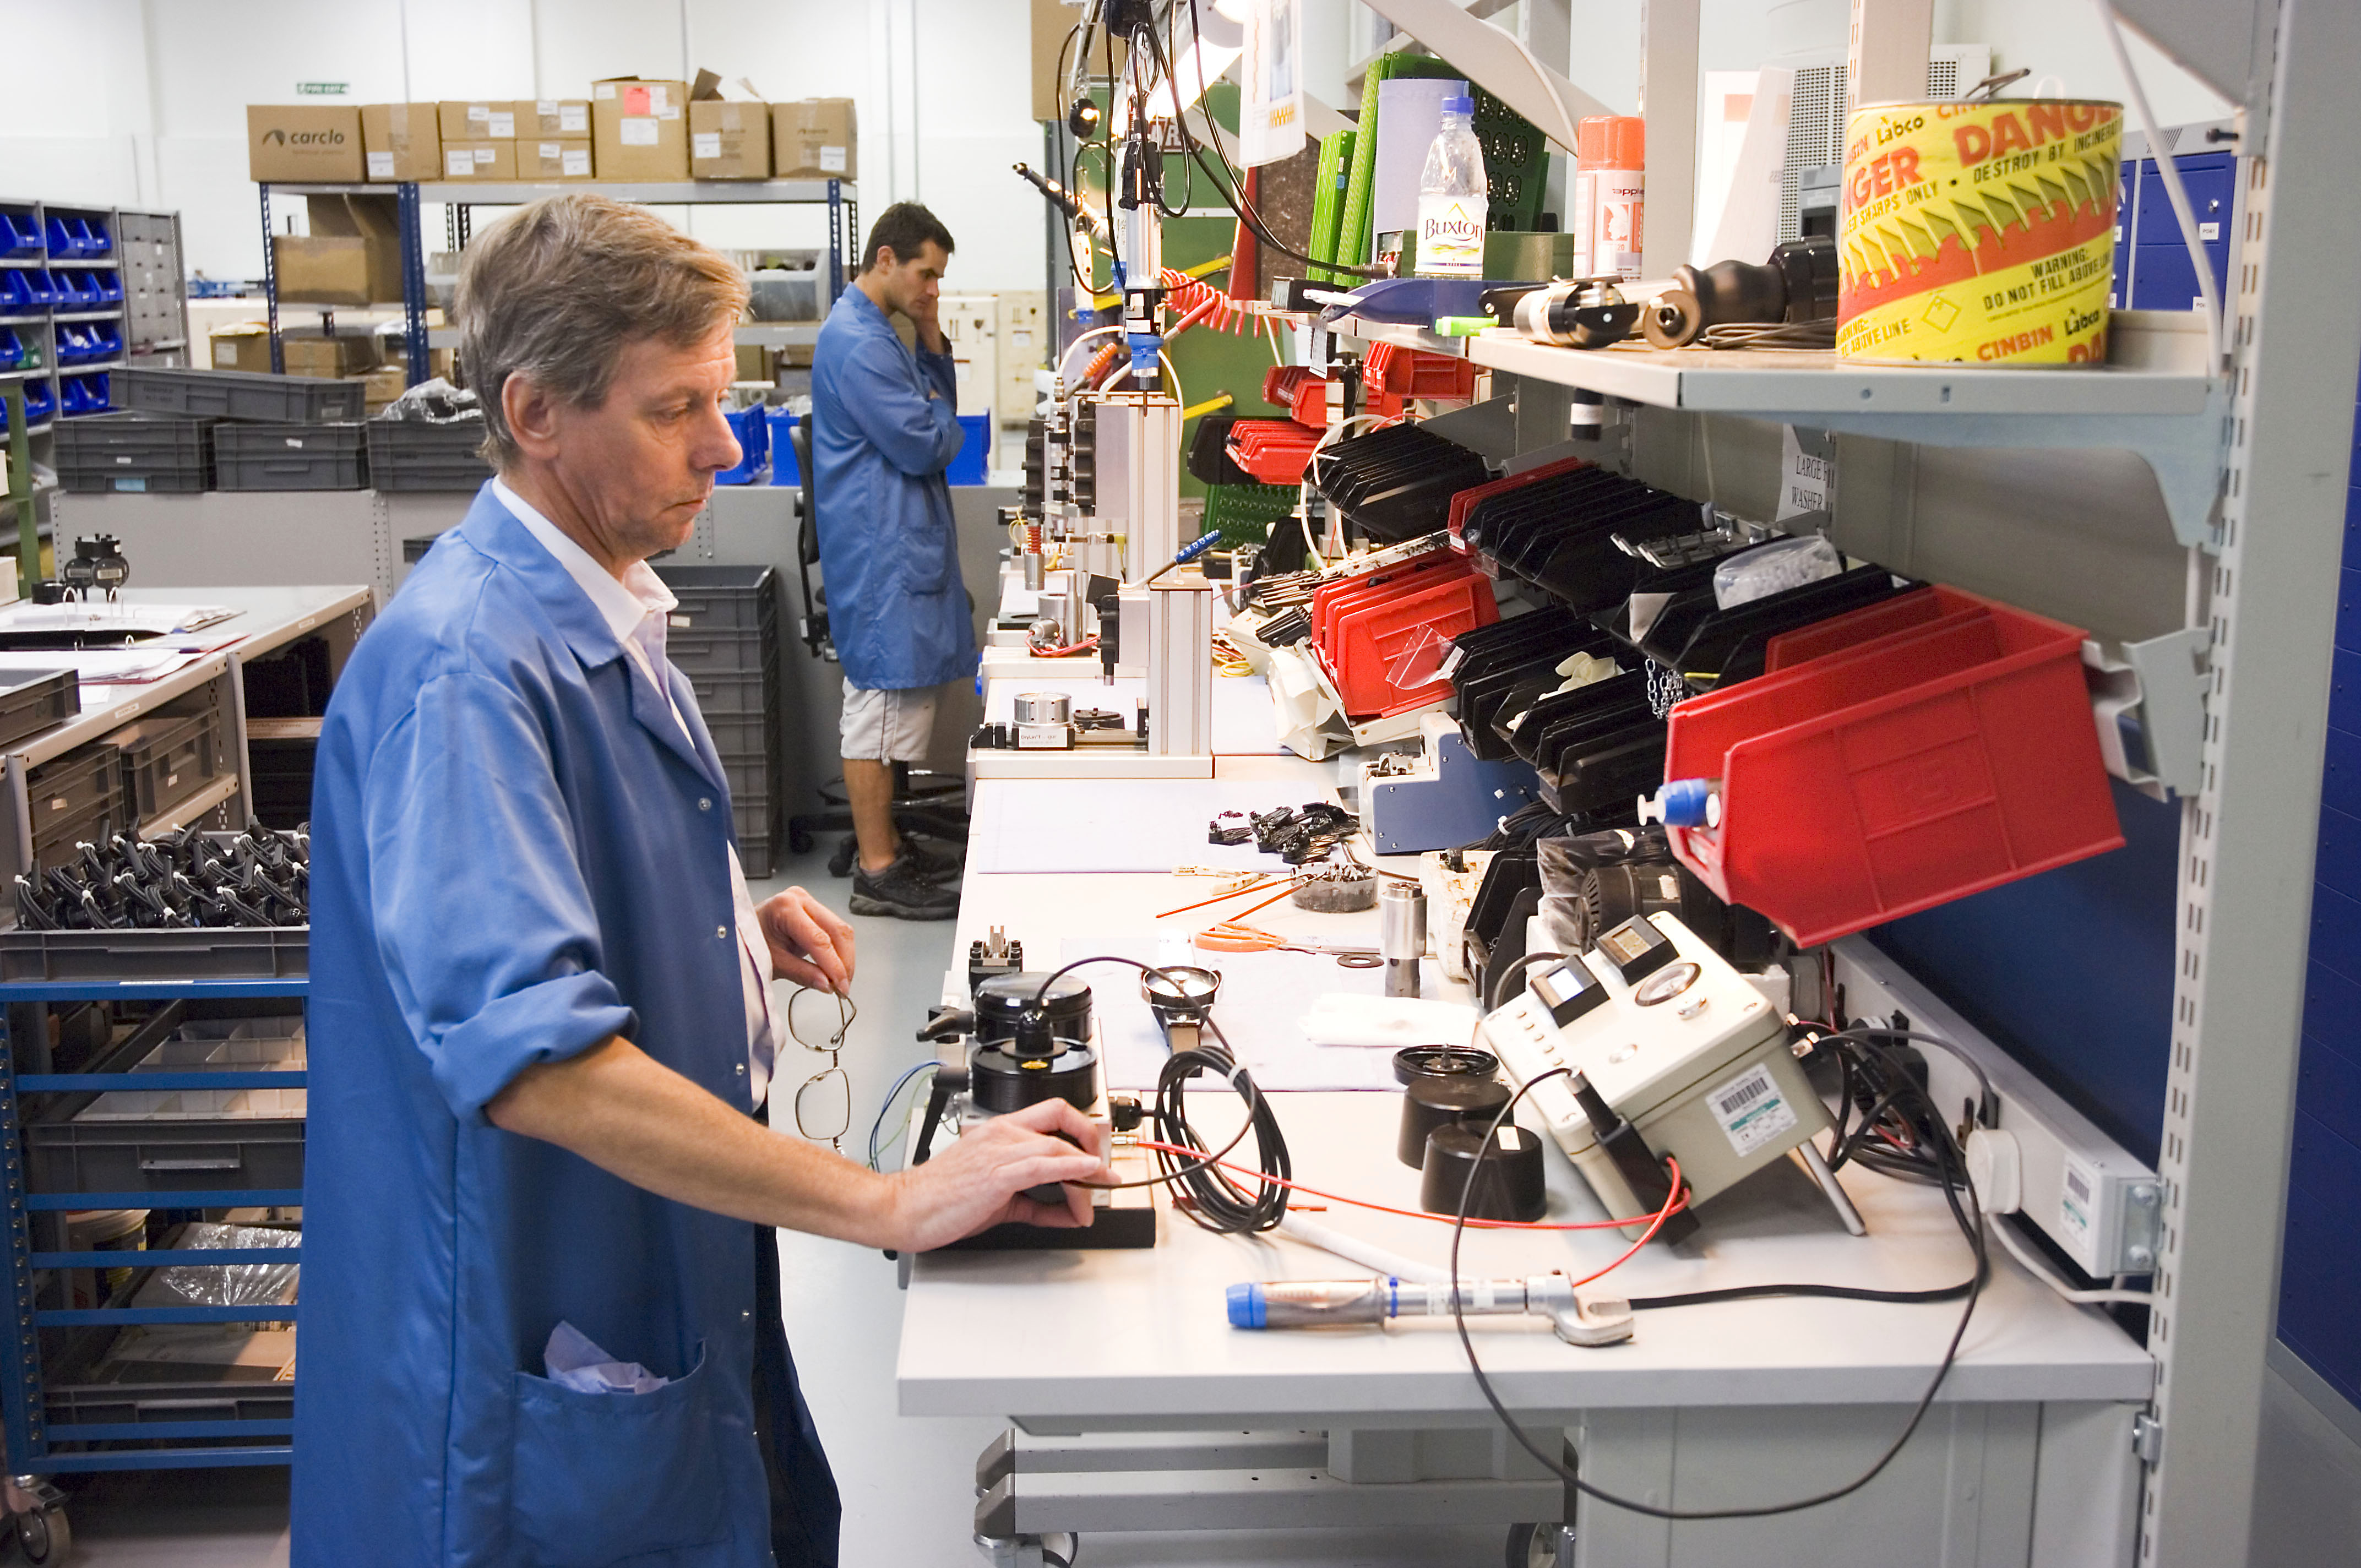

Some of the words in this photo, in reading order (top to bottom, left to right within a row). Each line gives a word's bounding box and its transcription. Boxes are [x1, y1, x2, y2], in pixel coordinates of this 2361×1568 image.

[291, 128, 344, 144] carclo
[1876, 116, 1924, 145] Labco
[1973, 151, 2039, 184] DESTROY
[2048, 142, 2064, 161] BY
[1859, 194, 1900, 226] SHARPS
[1906, 182, 1938, 204] ONLY
[1425, 218, 1483, 242] Buxton
[2031, 248, 2088, 278] WARNING:
[1983, 293, 2003, 311] DO
[2008, 282, 2034, 304] NOT
[2039, 275, 2065, 295] FILL
[2069, 261, 2097, 284] ABOVE
[1881, 317, 1911, 340] LINE
[1977, 324, 2053, 362] CINBIN
[1796, 455, 1821, 480] LARGE
[1792, 486, 1823, 510] WASHER
